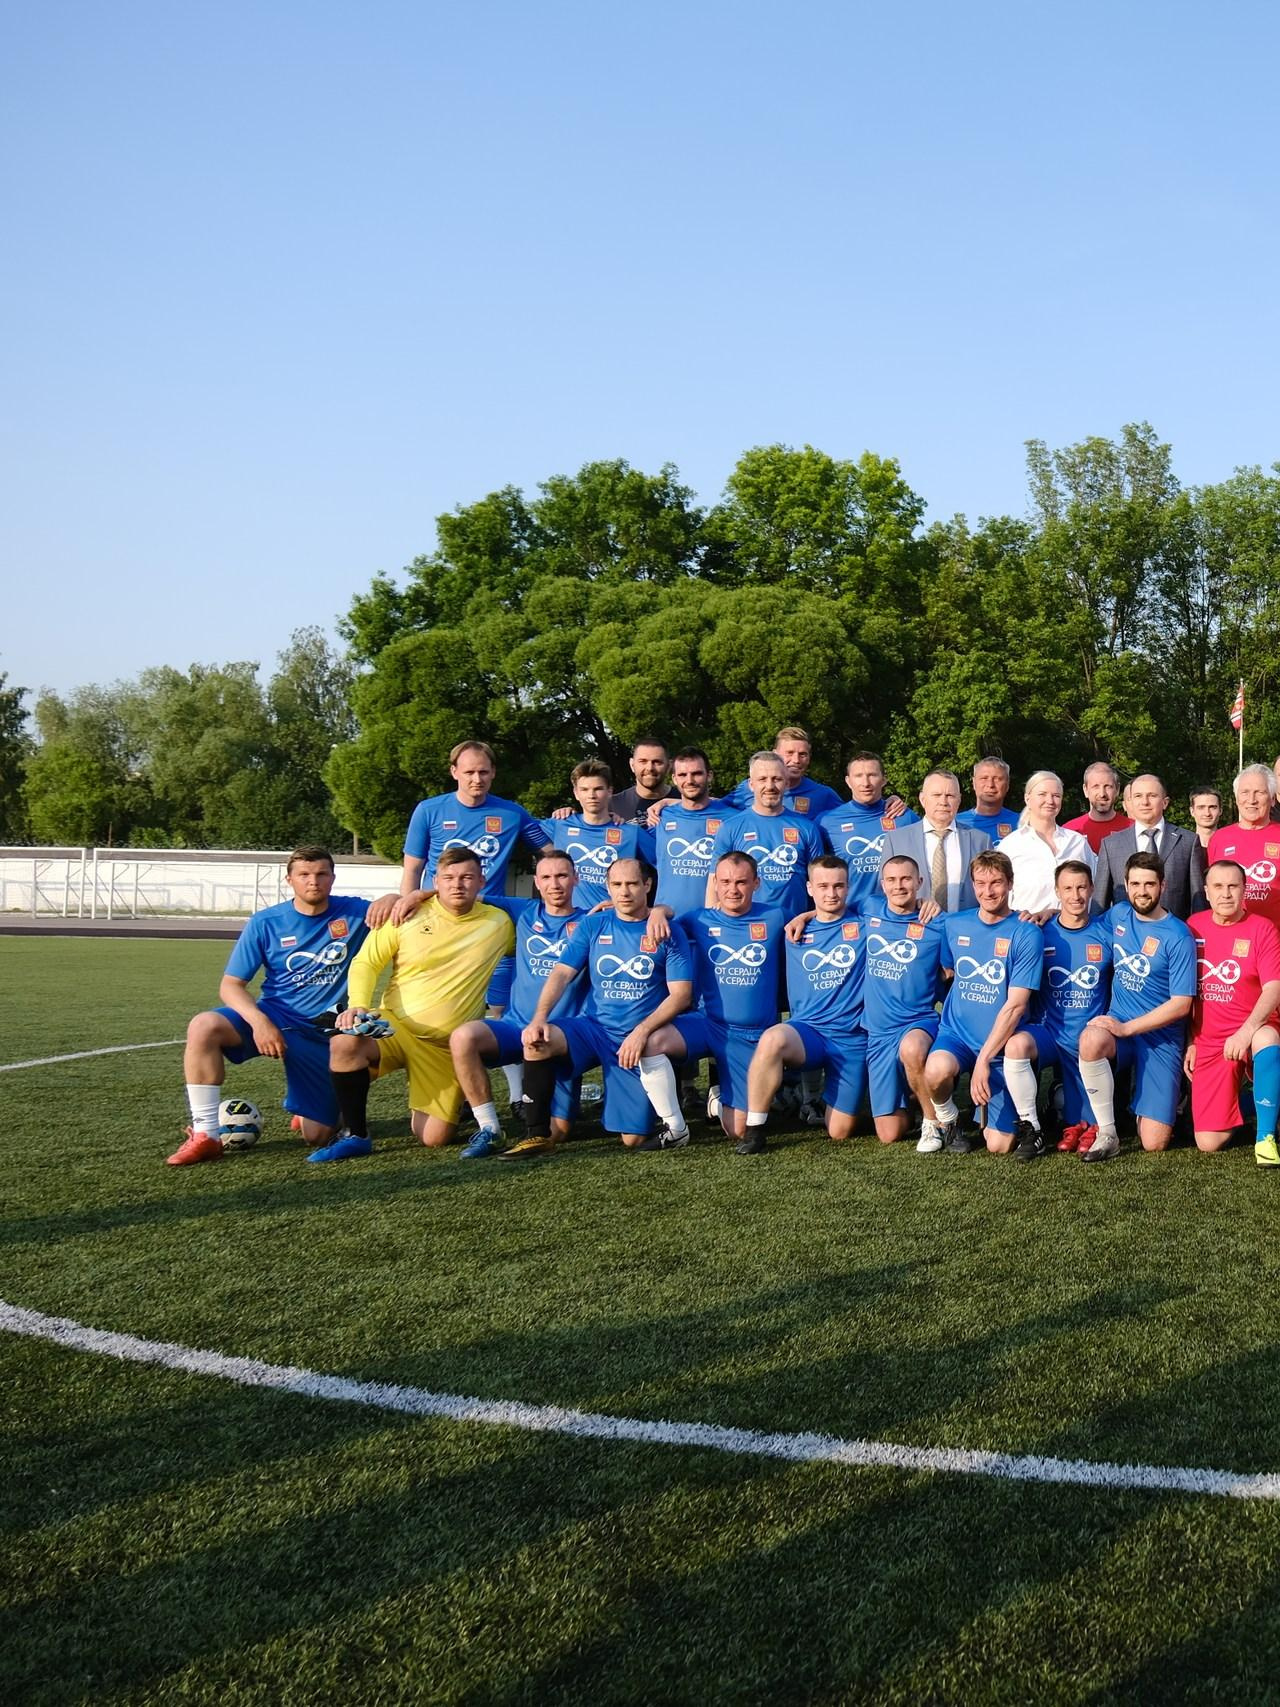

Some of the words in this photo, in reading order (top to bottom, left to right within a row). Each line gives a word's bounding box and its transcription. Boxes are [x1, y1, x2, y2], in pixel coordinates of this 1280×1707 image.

[679, 868, 708, 876] СЕРДЦУ
[1245, 883, 1271, 891] ЕРДЦА
[1244, 892, 1268, 901] ЕРДЦУ
[529, 958, 541, 966] ОТ
[868, 958, 878, 966] ОТ
[877, 961, 908, 972] СЕРДЦА
[728, 967, 761, 976] СЕРДЦА
[874, 969, 903, 980] СЕРДЦУ
[726, 977, 758, 985] СЕРДЦУ
[809, 973, 819, 981] ОТ
[601, 981, 612, 989] ОТ
[614, 981, 649, 990] СЕРДЦА
[959, 981, 970, 989] ОТ
[970, 983, 1000, 994] СЕРДЦА
[1206, 983, 1235, 993] СЕРДЦА
[610, 991, 644, 1000] СЕРДЦУ
[967, 993, 997, 1004] СЕРДЦУ
[1064, 990, 1096, 999] СЕРДЦА
[1204, 993, 1233, 1003] СЕРДЦУ
[1062, 1000, 1093, 1008] СЕРДЦУ
